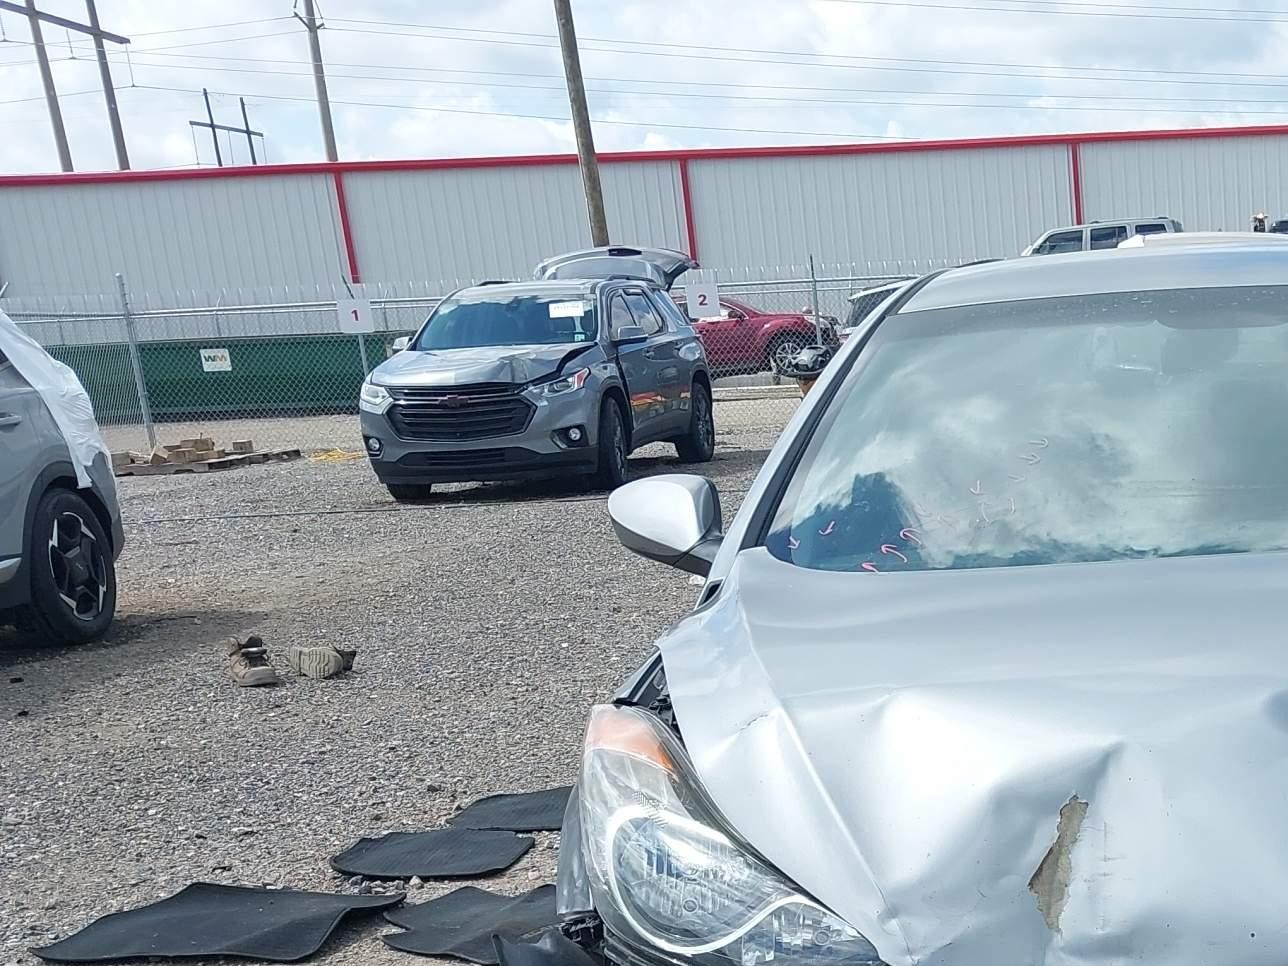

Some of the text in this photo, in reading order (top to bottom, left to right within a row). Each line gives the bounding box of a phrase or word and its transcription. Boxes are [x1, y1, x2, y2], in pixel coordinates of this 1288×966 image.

[697, 294, 708, 306] 2
[351, 309, 359, 322] 1
[203, 355, 228, 363] WM
